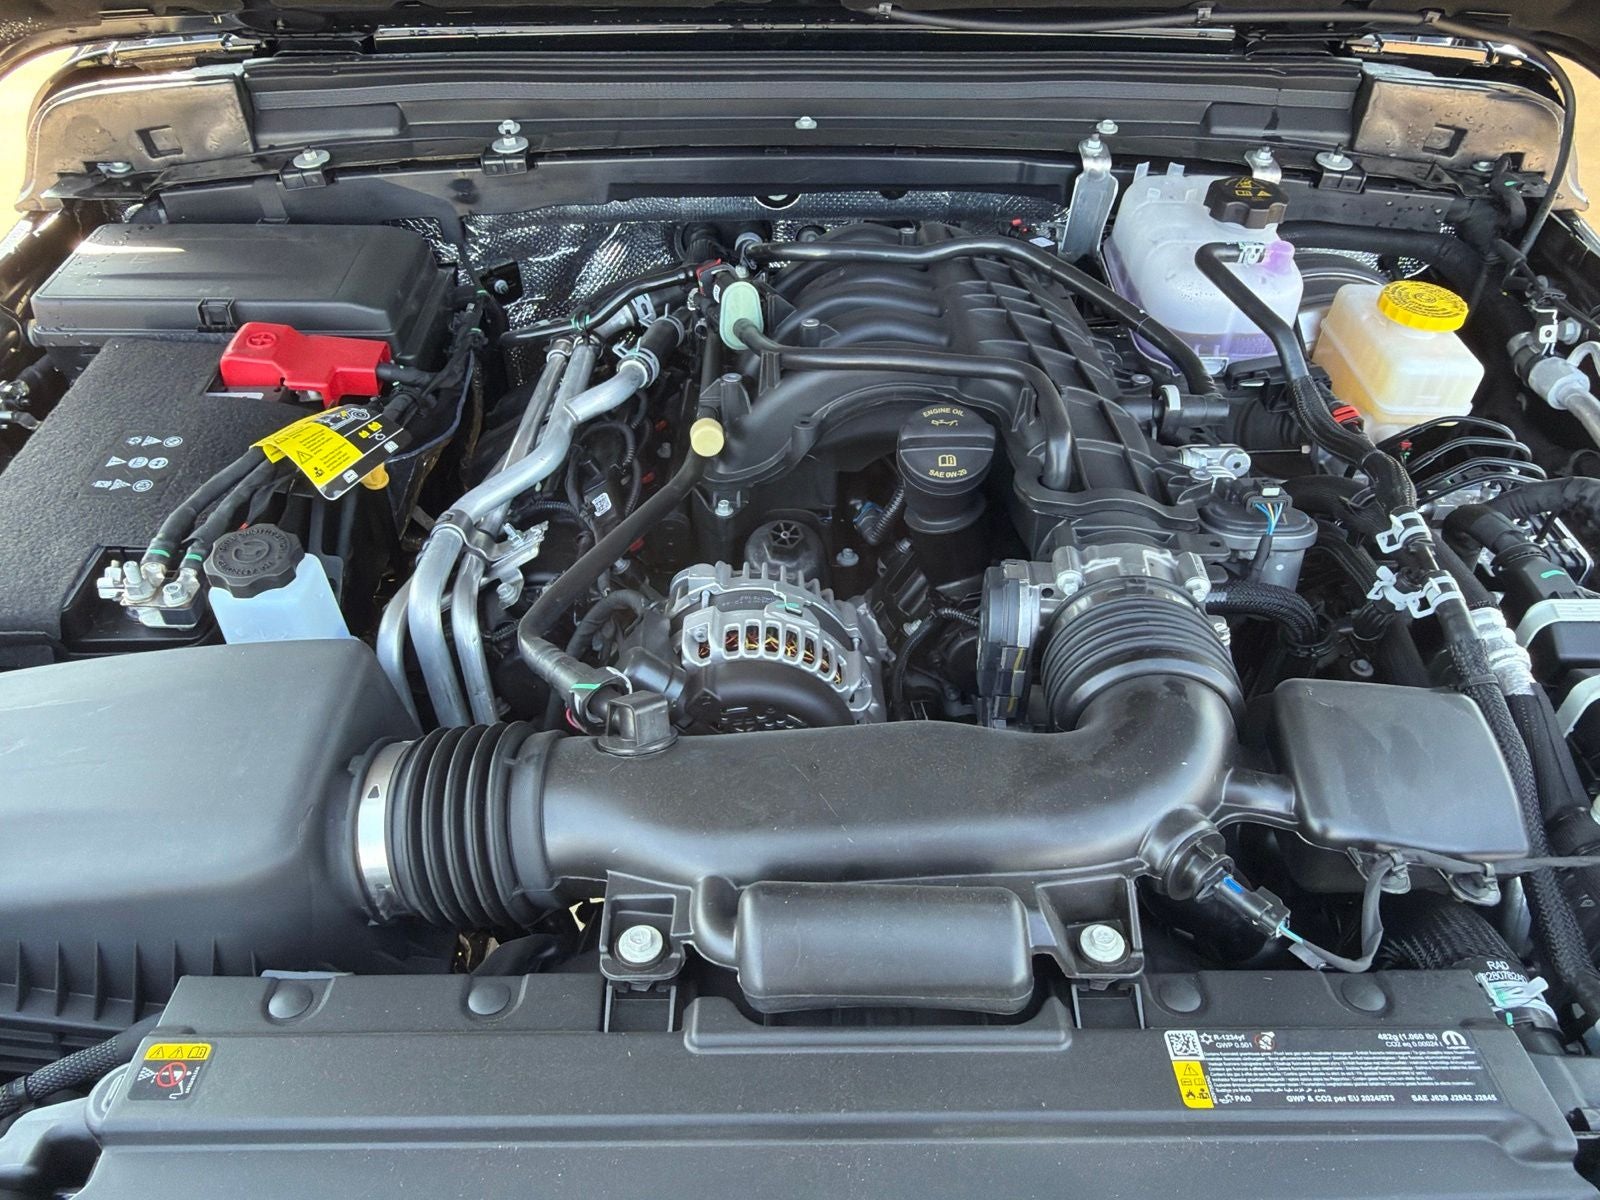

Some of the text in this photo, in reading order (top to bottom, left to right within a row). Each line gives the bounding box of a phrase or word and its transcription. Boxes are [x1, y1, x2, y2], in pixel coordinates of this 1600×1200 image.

[922, 407, 965, 418] ENGINE OIL
[928, 468, 968, 478] SAE 0W-20
[1486, 960, 1510, 971] RAD
[1213, 1034, 1246, 1042] R-1234yf
[1215, 1041, 1233, 1049] GWP
[1234, 1095, 1252, 1103] PAG
[1286, 1095, 1306, 1103] GWP
[1314, 1094, 1333, 1103] CO2
[1333, 1096, 1347, 1104] per
[1347, 1094, 1360, 1103] EU
[1410, 1094, 1430, 1102] SAE
